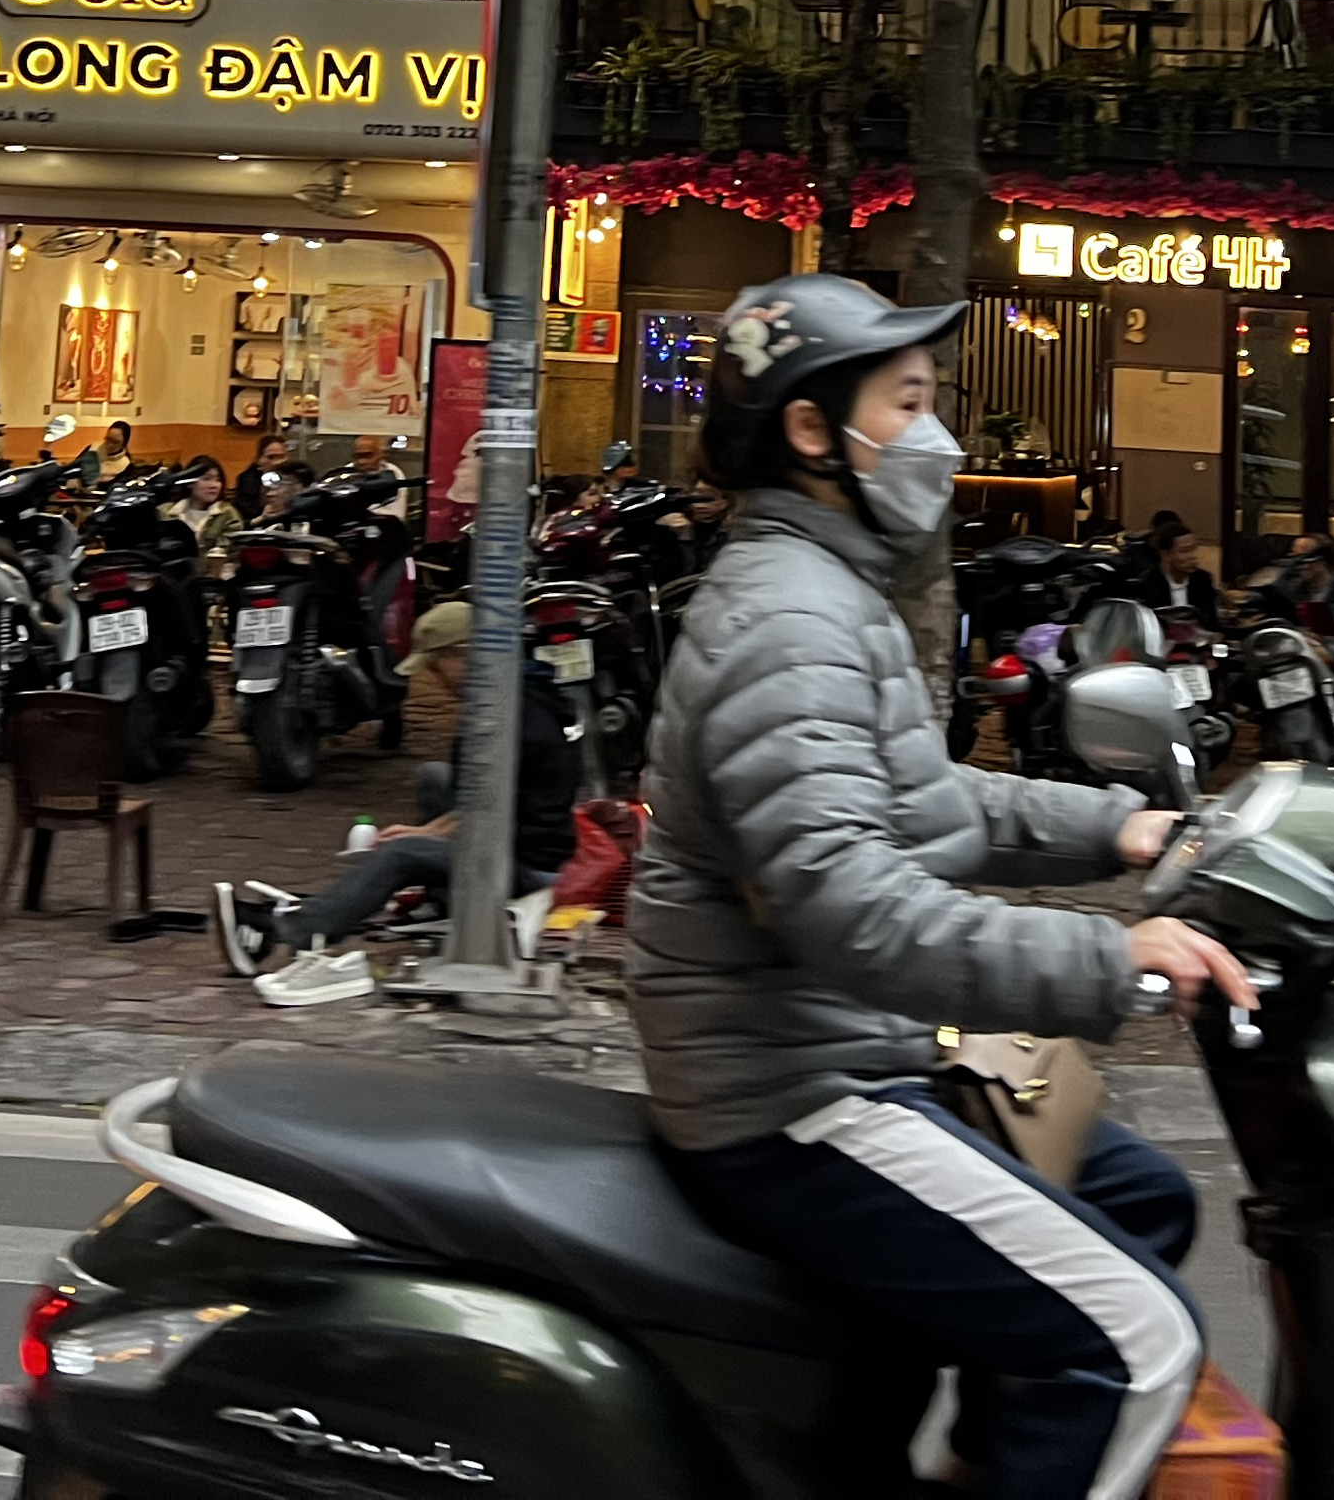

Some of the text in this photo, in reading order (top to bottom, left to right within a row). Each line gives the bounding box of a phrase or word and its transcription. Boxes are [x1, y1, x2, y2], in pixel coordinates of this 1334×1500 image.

[201, 35, 379, 112] ĐẬM
[405, 50, 487, 120] VỊ
[1079, 231, 1207, 287] Café
[1124, 308, 1147, 344] 2
